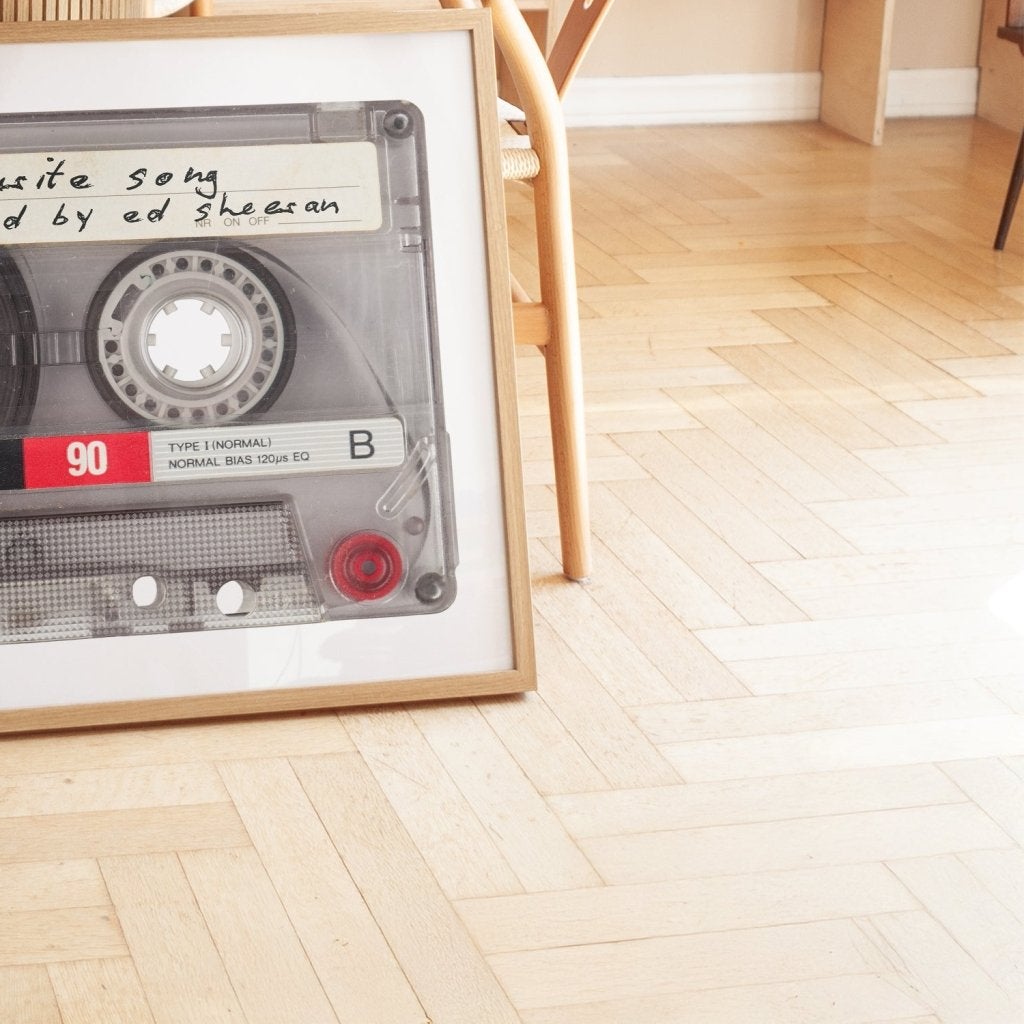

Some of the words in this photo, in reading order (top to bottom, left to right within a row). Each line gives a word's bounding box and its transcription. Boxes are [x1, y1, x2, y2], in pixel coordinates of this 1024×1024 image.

[126, 167, 218, 199] song
[52, 203, 93, 232] by
[123, 198, 170, 223] ed
[223, 216, 241, 227] ON
[248, 215, 270, 226] OFF
[66, 440, 108, 476] 90
[168, 441, 200, 452] TYPE
[211, 437, 272, 451] (NORMAL)
[349, 429, 375, 459] B
[168, 456, 221, 469] NORMAL
[225, 454, 253, 465] BIAS
[293, 451, 310, 462] EQ
